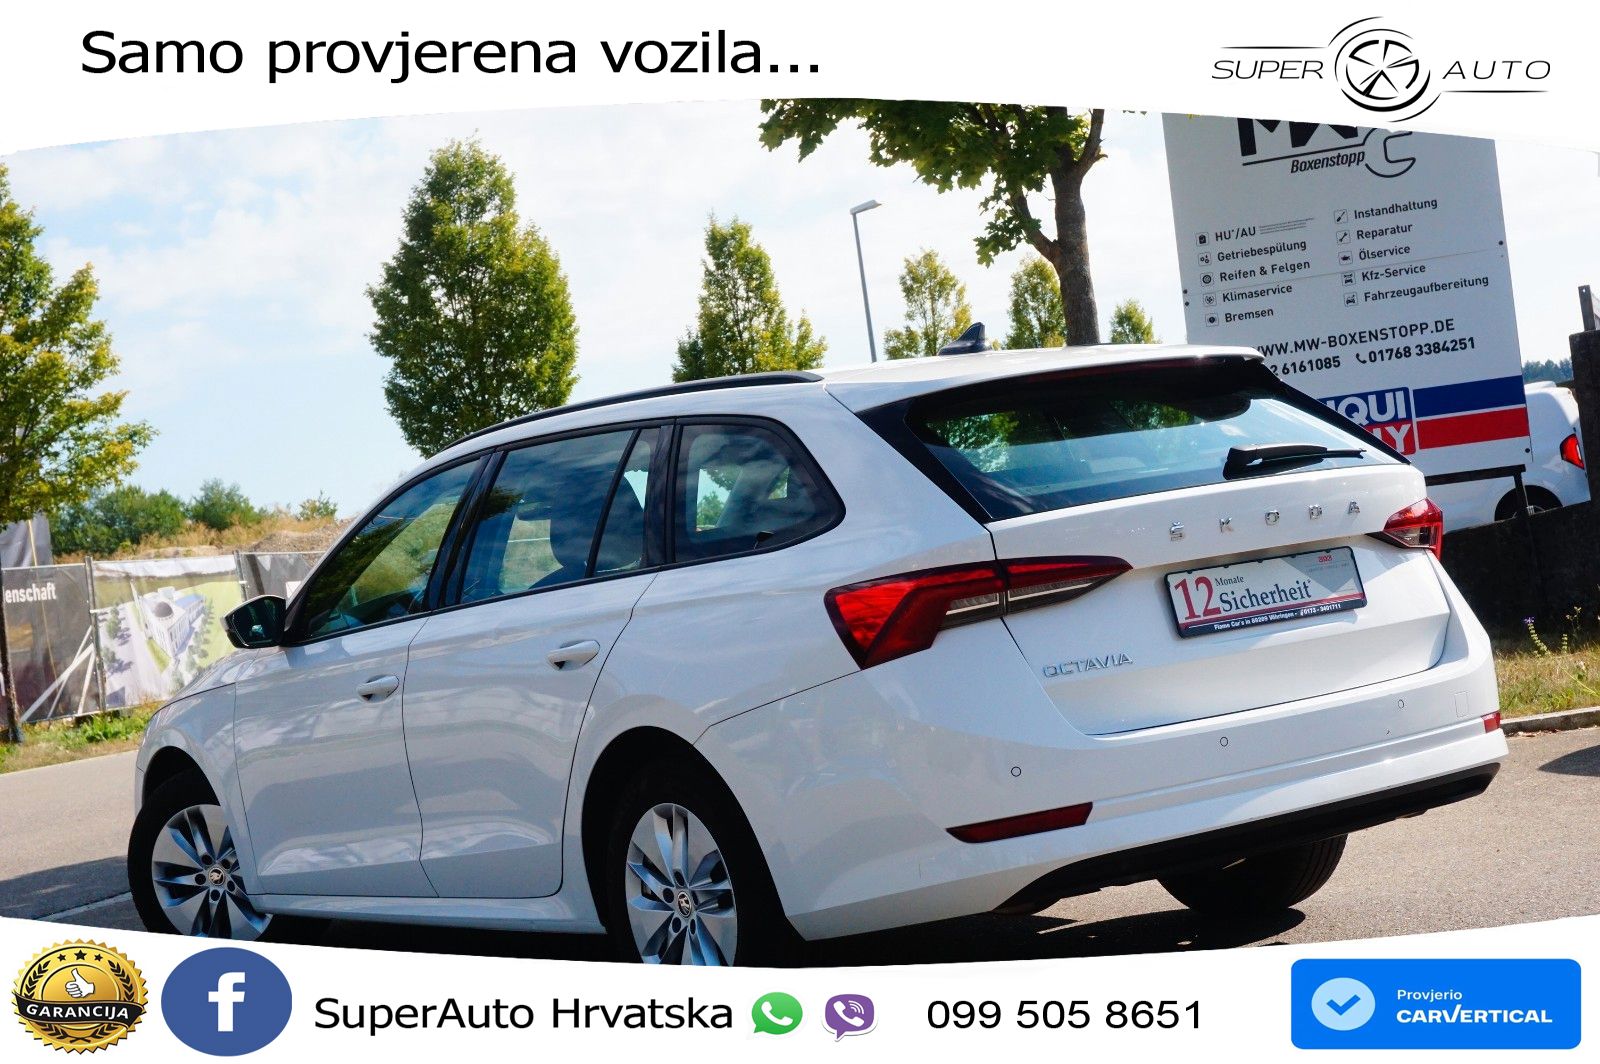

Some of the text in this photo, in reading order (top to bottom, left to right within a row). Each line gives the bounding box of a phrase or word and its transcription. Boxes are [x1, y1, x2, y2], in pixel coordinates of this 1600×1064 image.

[1290, 150, 1366, 174] Boxenstopp
[1353, 199, 1438, 220] Instandhaltung
[1356, 222, 1414, 241] Reparatur
[1216, 240, 1308, 262] Getriebespülung
[1358, 244, 1411, 261] Ölservice
[1219, 260, 1311, 283] Reifen & Felgen
[1361, 263, 1427, 282] Kfz-Service
[1222, 284, 1293, 303] Klimaservice
[1364, 276, 1490, 302] Fahrzeugaufbereitung
[1224, 307, 1275, 324] Bremsen
[1368, 336, 1476, 364] 01768 3384251
[1281, 355, 1342, 376] 6161085
[1214, 575, 1245, 587] Monate
[1173, 575, 1222, 621] 12
[1043, 652, 1134, 679] OCTAVIA
